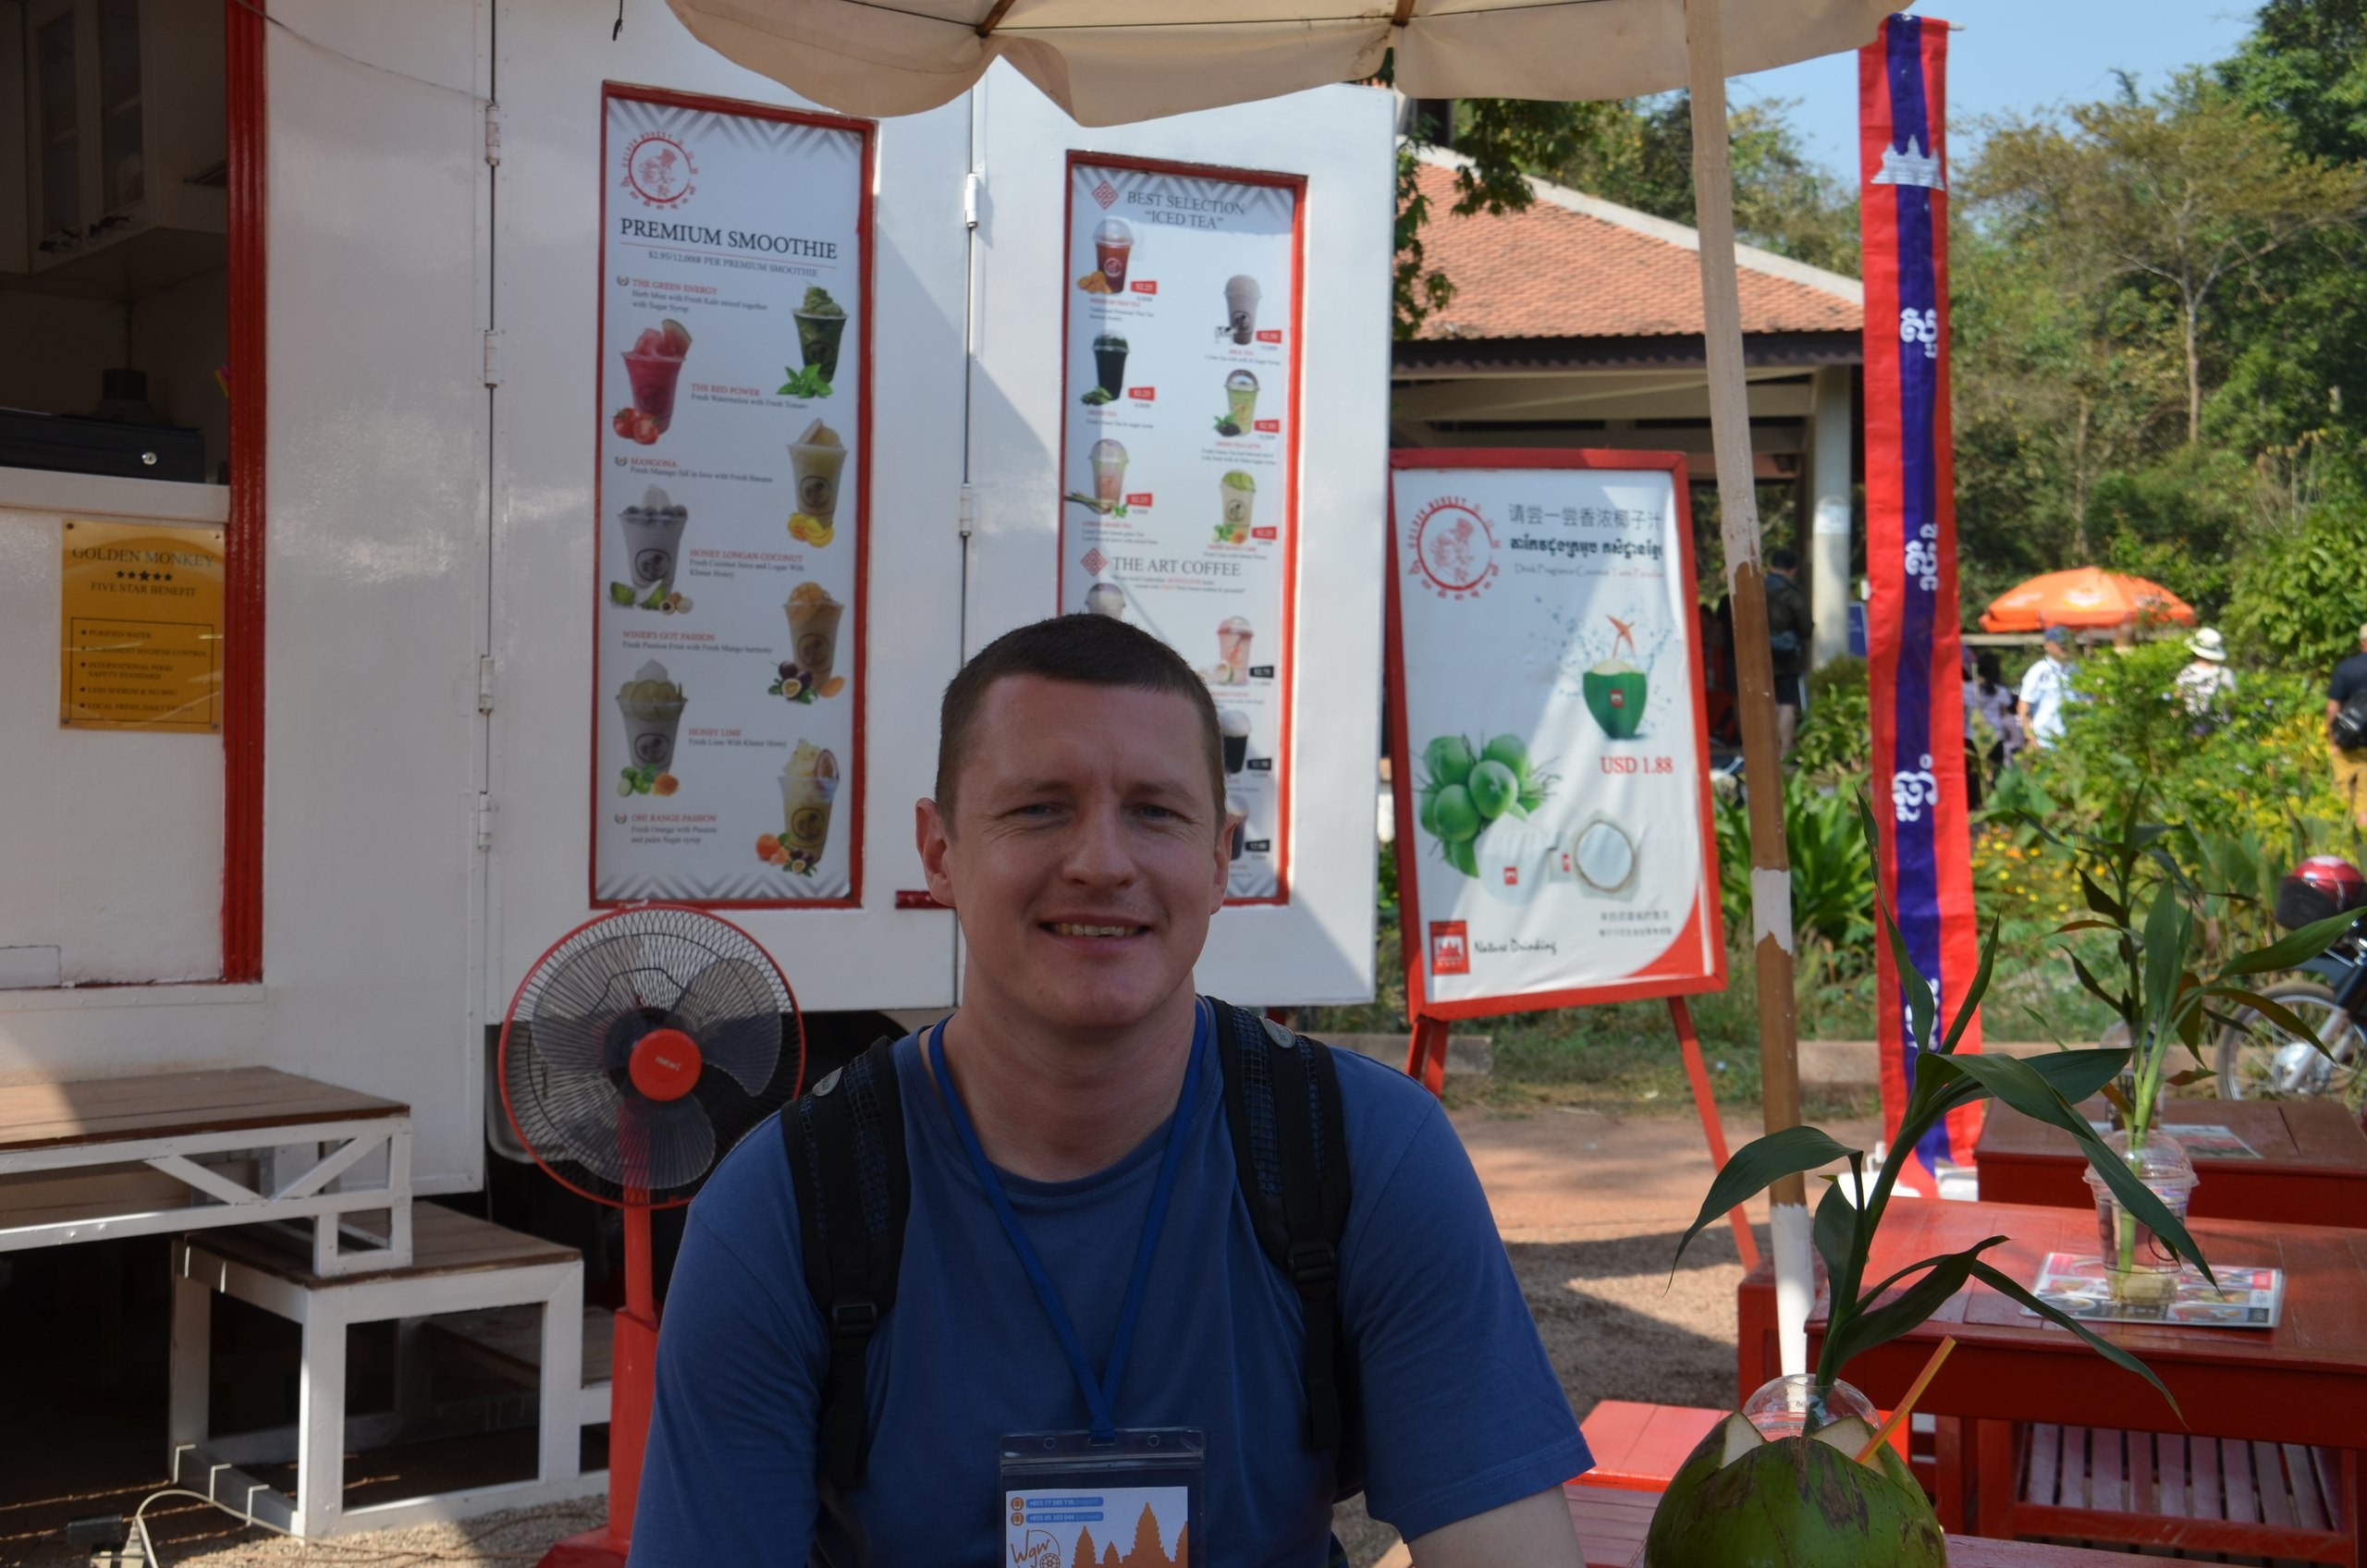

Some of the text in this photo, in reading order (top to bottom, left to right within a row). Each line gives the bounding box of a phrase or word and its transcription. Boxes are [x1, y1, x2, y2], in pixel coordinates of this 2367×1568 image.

[1126, 191, 1245, 215] BEST SELECTION
[620, 218, 837, 259] PREMIUM SMOOTHIE
[704, 257, 720, 266] PER
[723, 259, 767, 271] PREMIUM
[769, 263, 817, 276] SMOOTHIE
[632, 279, 717, 295] THE GREEN ENERGY
[668, 293, 682, 302] with
[685, 295, 702, 304] Fresh
[649, 301, 672, 312] Sugar
[674, 304, 689, 314] Syrup
[692, 384, 760, 396] THE RED POWER
[692, 393, 708, 401] Fresh
[631, 466, 648, 474] Fresh
[730, 473, 747, 482] Fresh
[73, 546, 214, 568] GOLDEN MONKEY
[690, 549, 803, 563] HONEY LONGAN COCONUT
[714, 570, 734, 579] Honey
[1112, 557, 1241, 577] THE ART COFFEE
[91, 582, 196, 597] FIVE STAR BENEFIT
[127, 631, 152, 639] WATER
[681, 633, 715, 642] PASSION
[1600, 757, 1674, 775] USD 1.88
[1475, 938, 1556, 956] Nature Drinking
